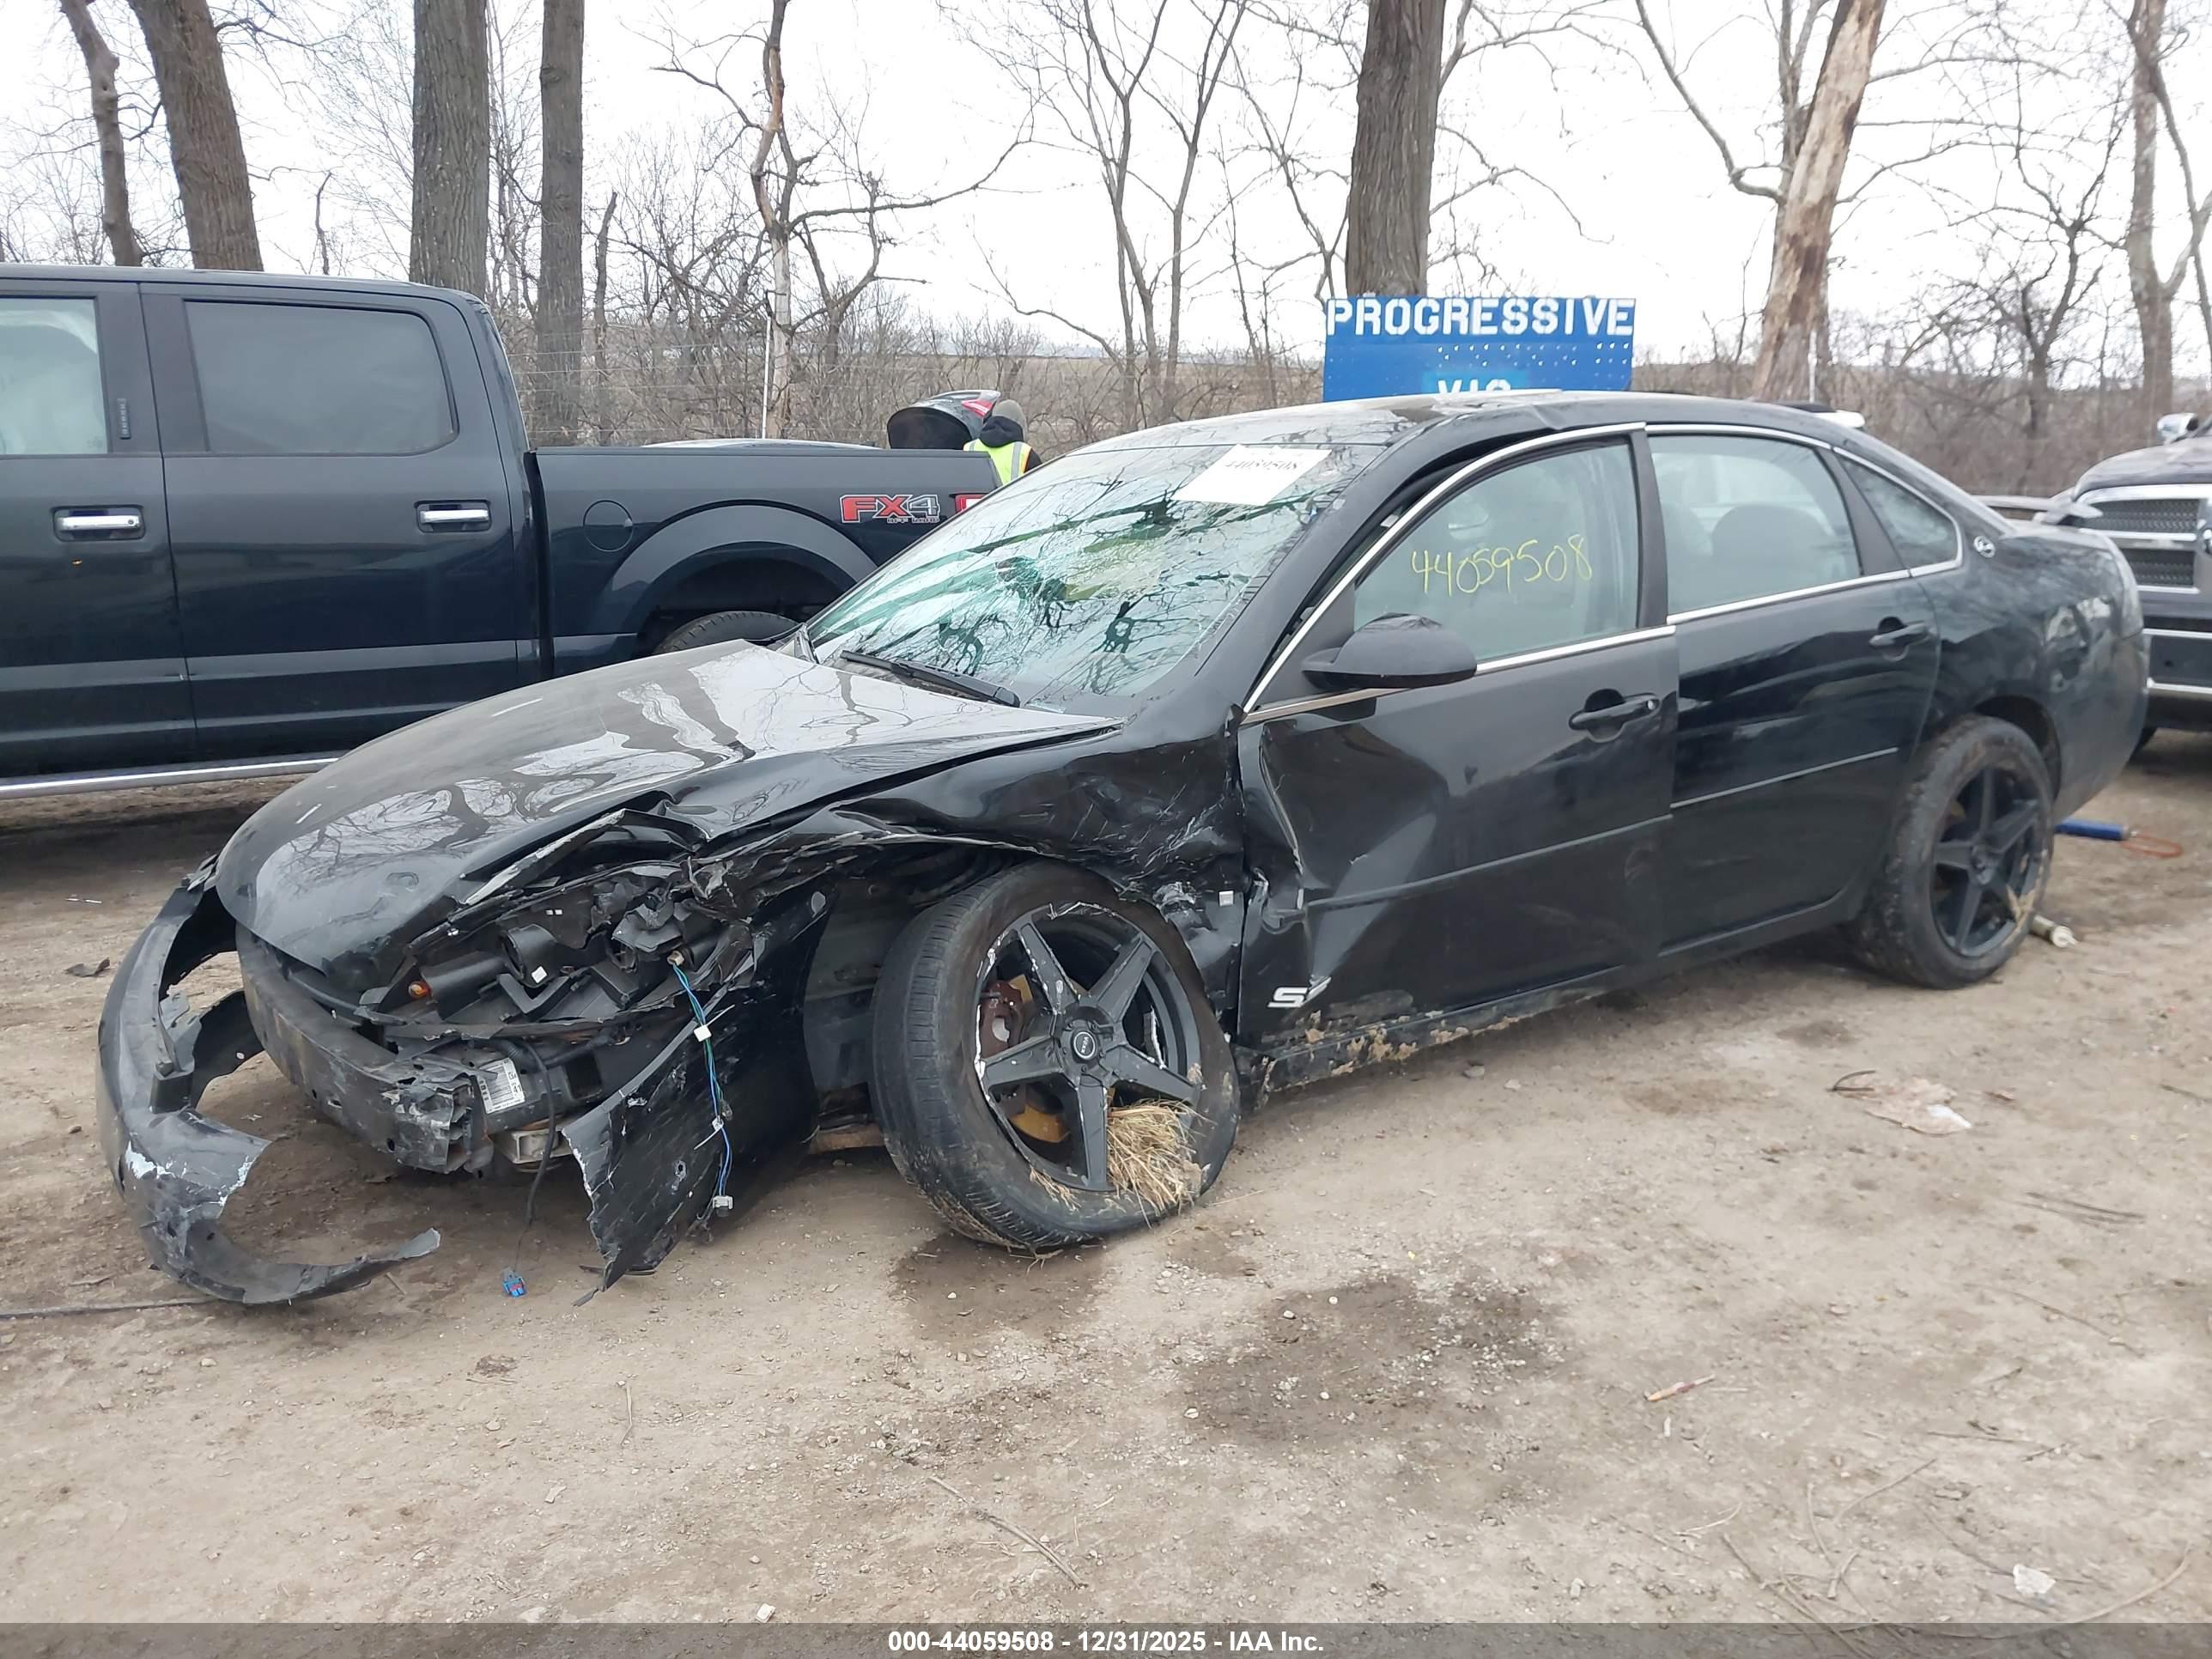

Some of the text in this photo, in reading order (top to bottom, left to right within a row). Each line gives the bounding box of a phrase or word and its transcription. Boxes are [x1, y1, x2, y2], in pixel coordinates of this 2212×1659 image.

[1327, 298, 1635, 336] PROGRESSIVE
[840, 494, 940, 523] FX4
[1412, 533, 1593, 597] 44059508
